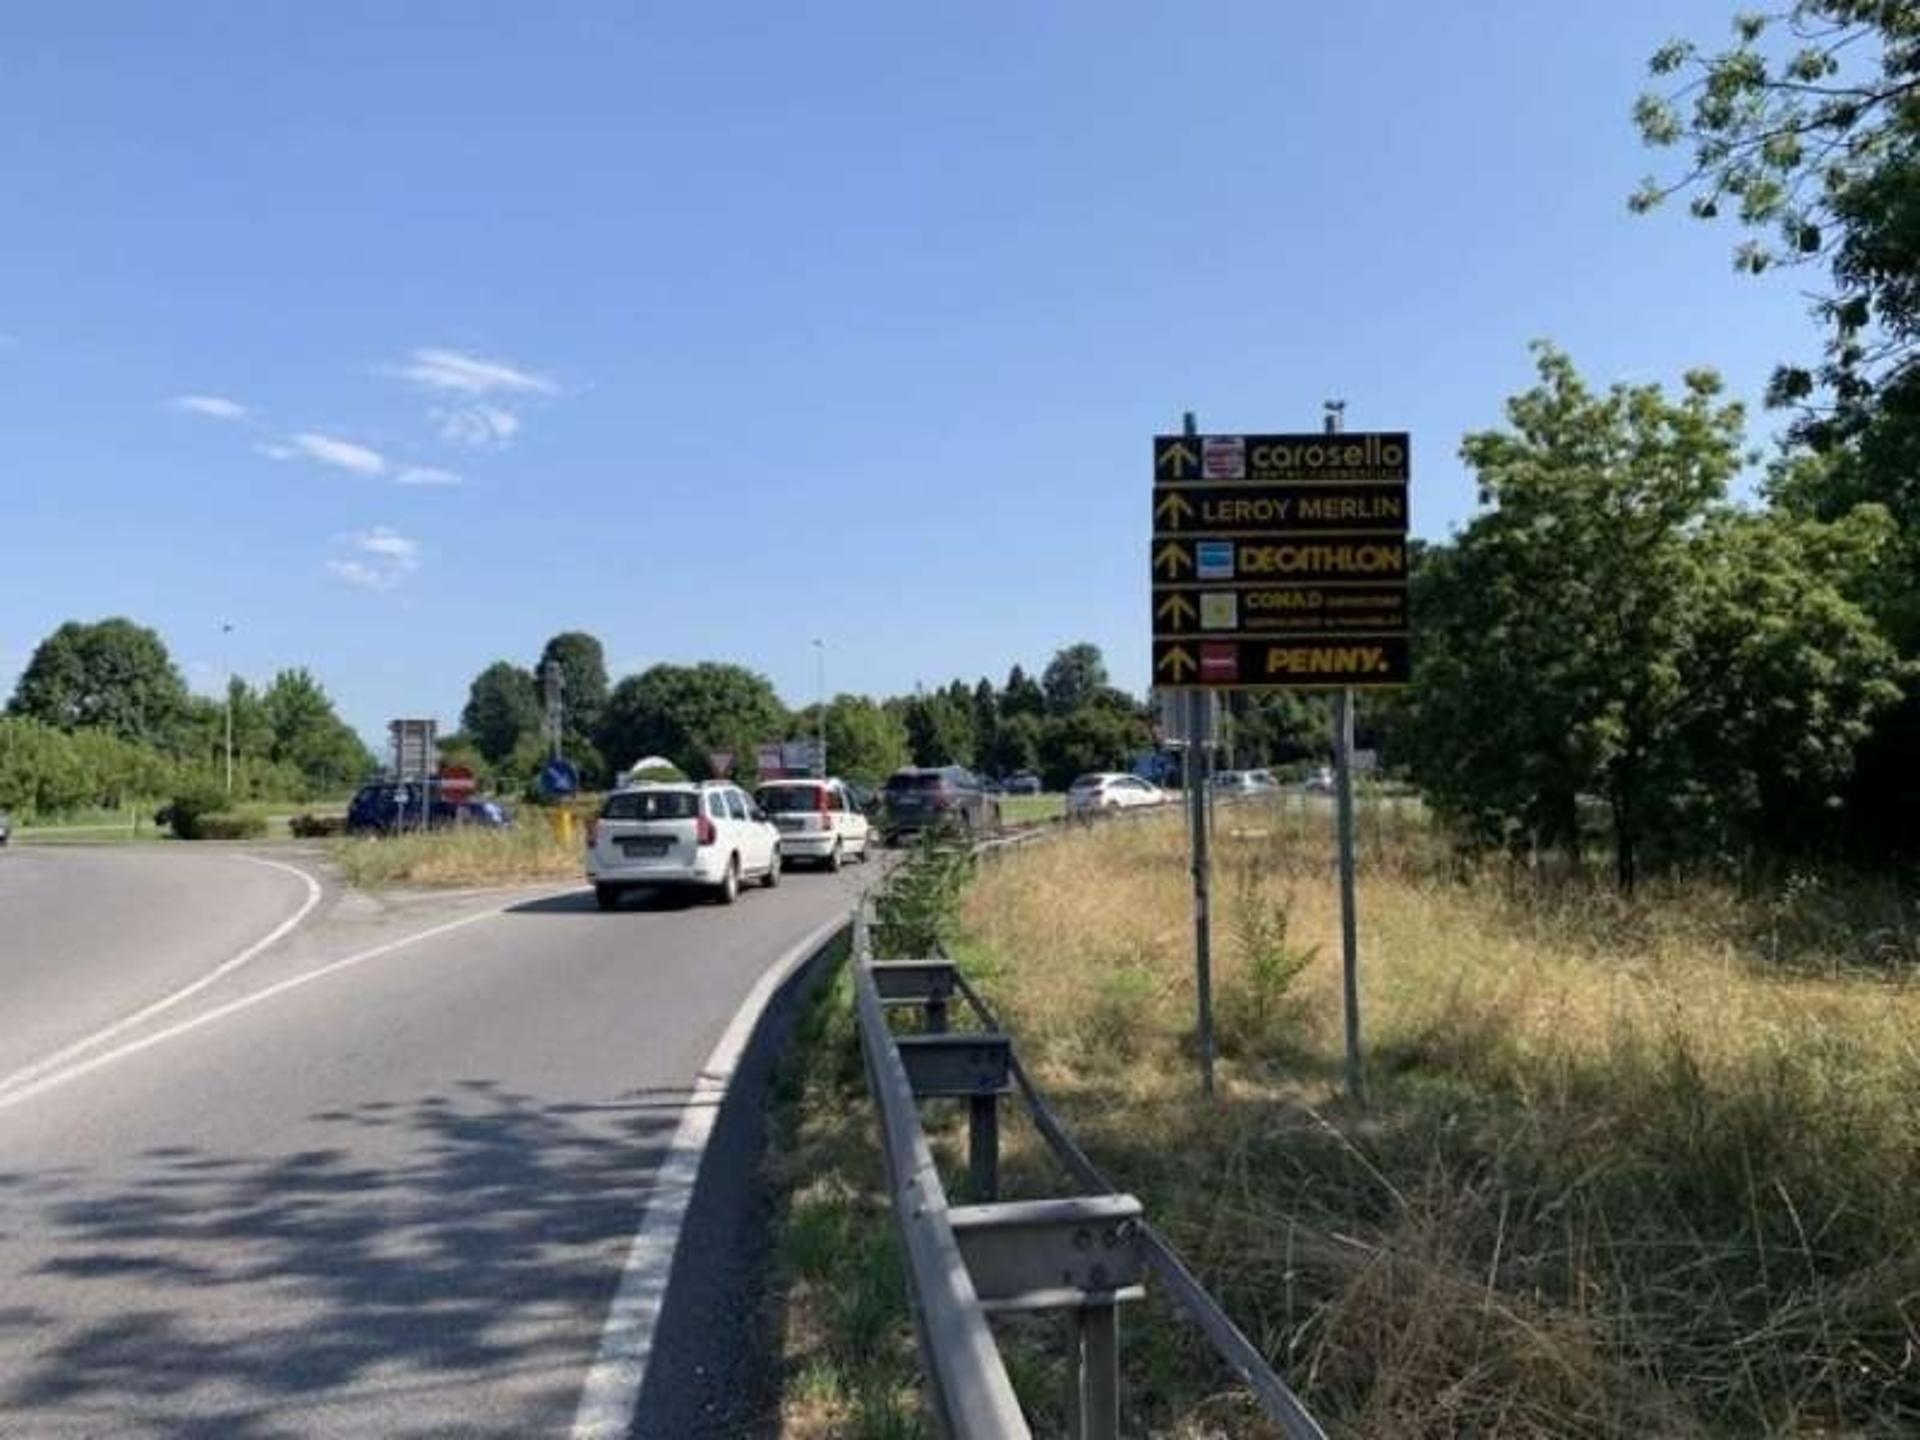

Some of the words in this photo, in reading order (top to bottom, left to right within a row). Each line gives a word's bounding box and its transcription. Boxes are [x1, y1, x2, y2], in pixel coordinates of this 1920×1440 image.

[1252, 434, 1403, 467] carosello
[1203, 499, 1290, 520] LEROY
[1299, 498, 1400, 519] MERLIN
[1239, 545, 1402, 573] DECATHLON
